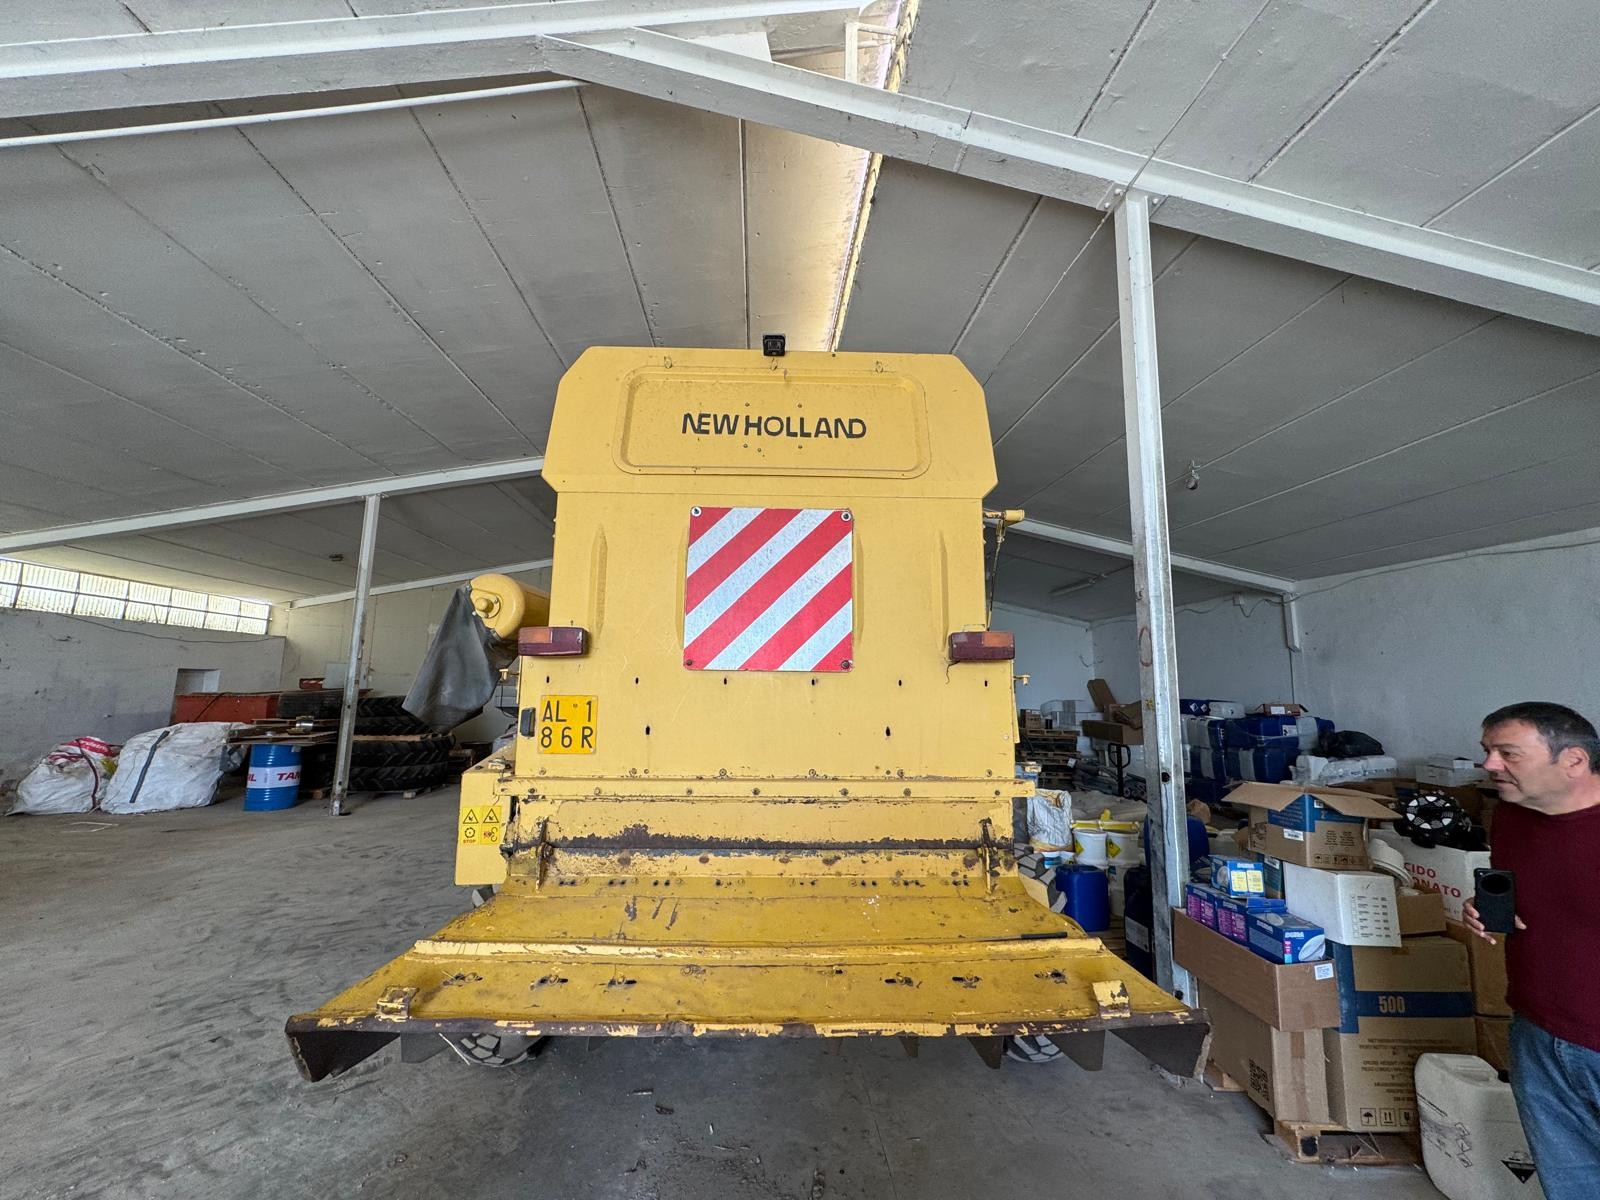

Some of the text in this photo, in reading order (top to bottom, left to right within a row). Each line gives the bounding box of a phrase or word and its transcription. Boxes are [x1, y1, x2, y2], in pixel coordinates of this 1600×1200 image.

[681, 412, 867, 439] NEW HOLLAND
[541, 700, 567, 723] AL
[1378, 995, 1406, 1014] 500
